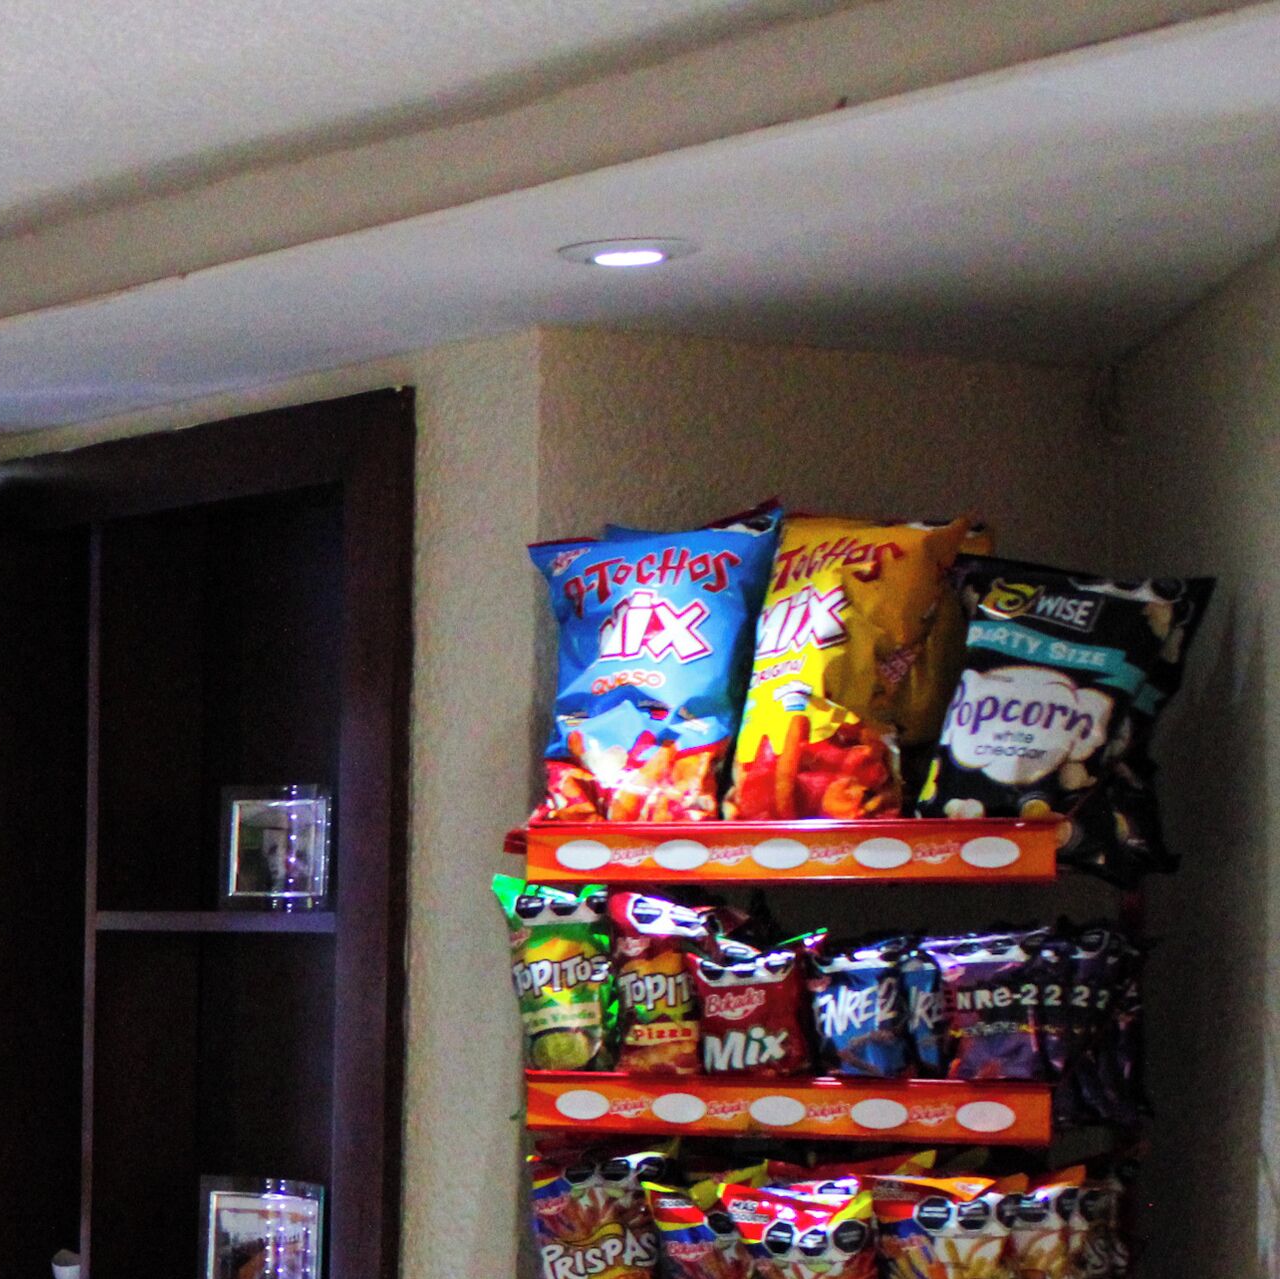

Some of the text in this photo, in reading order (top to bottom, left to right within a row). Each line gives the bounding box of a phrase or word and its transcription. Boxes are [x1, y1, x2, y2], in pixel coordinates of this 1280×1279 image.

[1035, 595, 1094, 625] WISE
[951, 682, 1094, 740] Popcorn
[618, 971, 693, 1012] TOPIT
[703, 1024, 790, 1074] Mix
